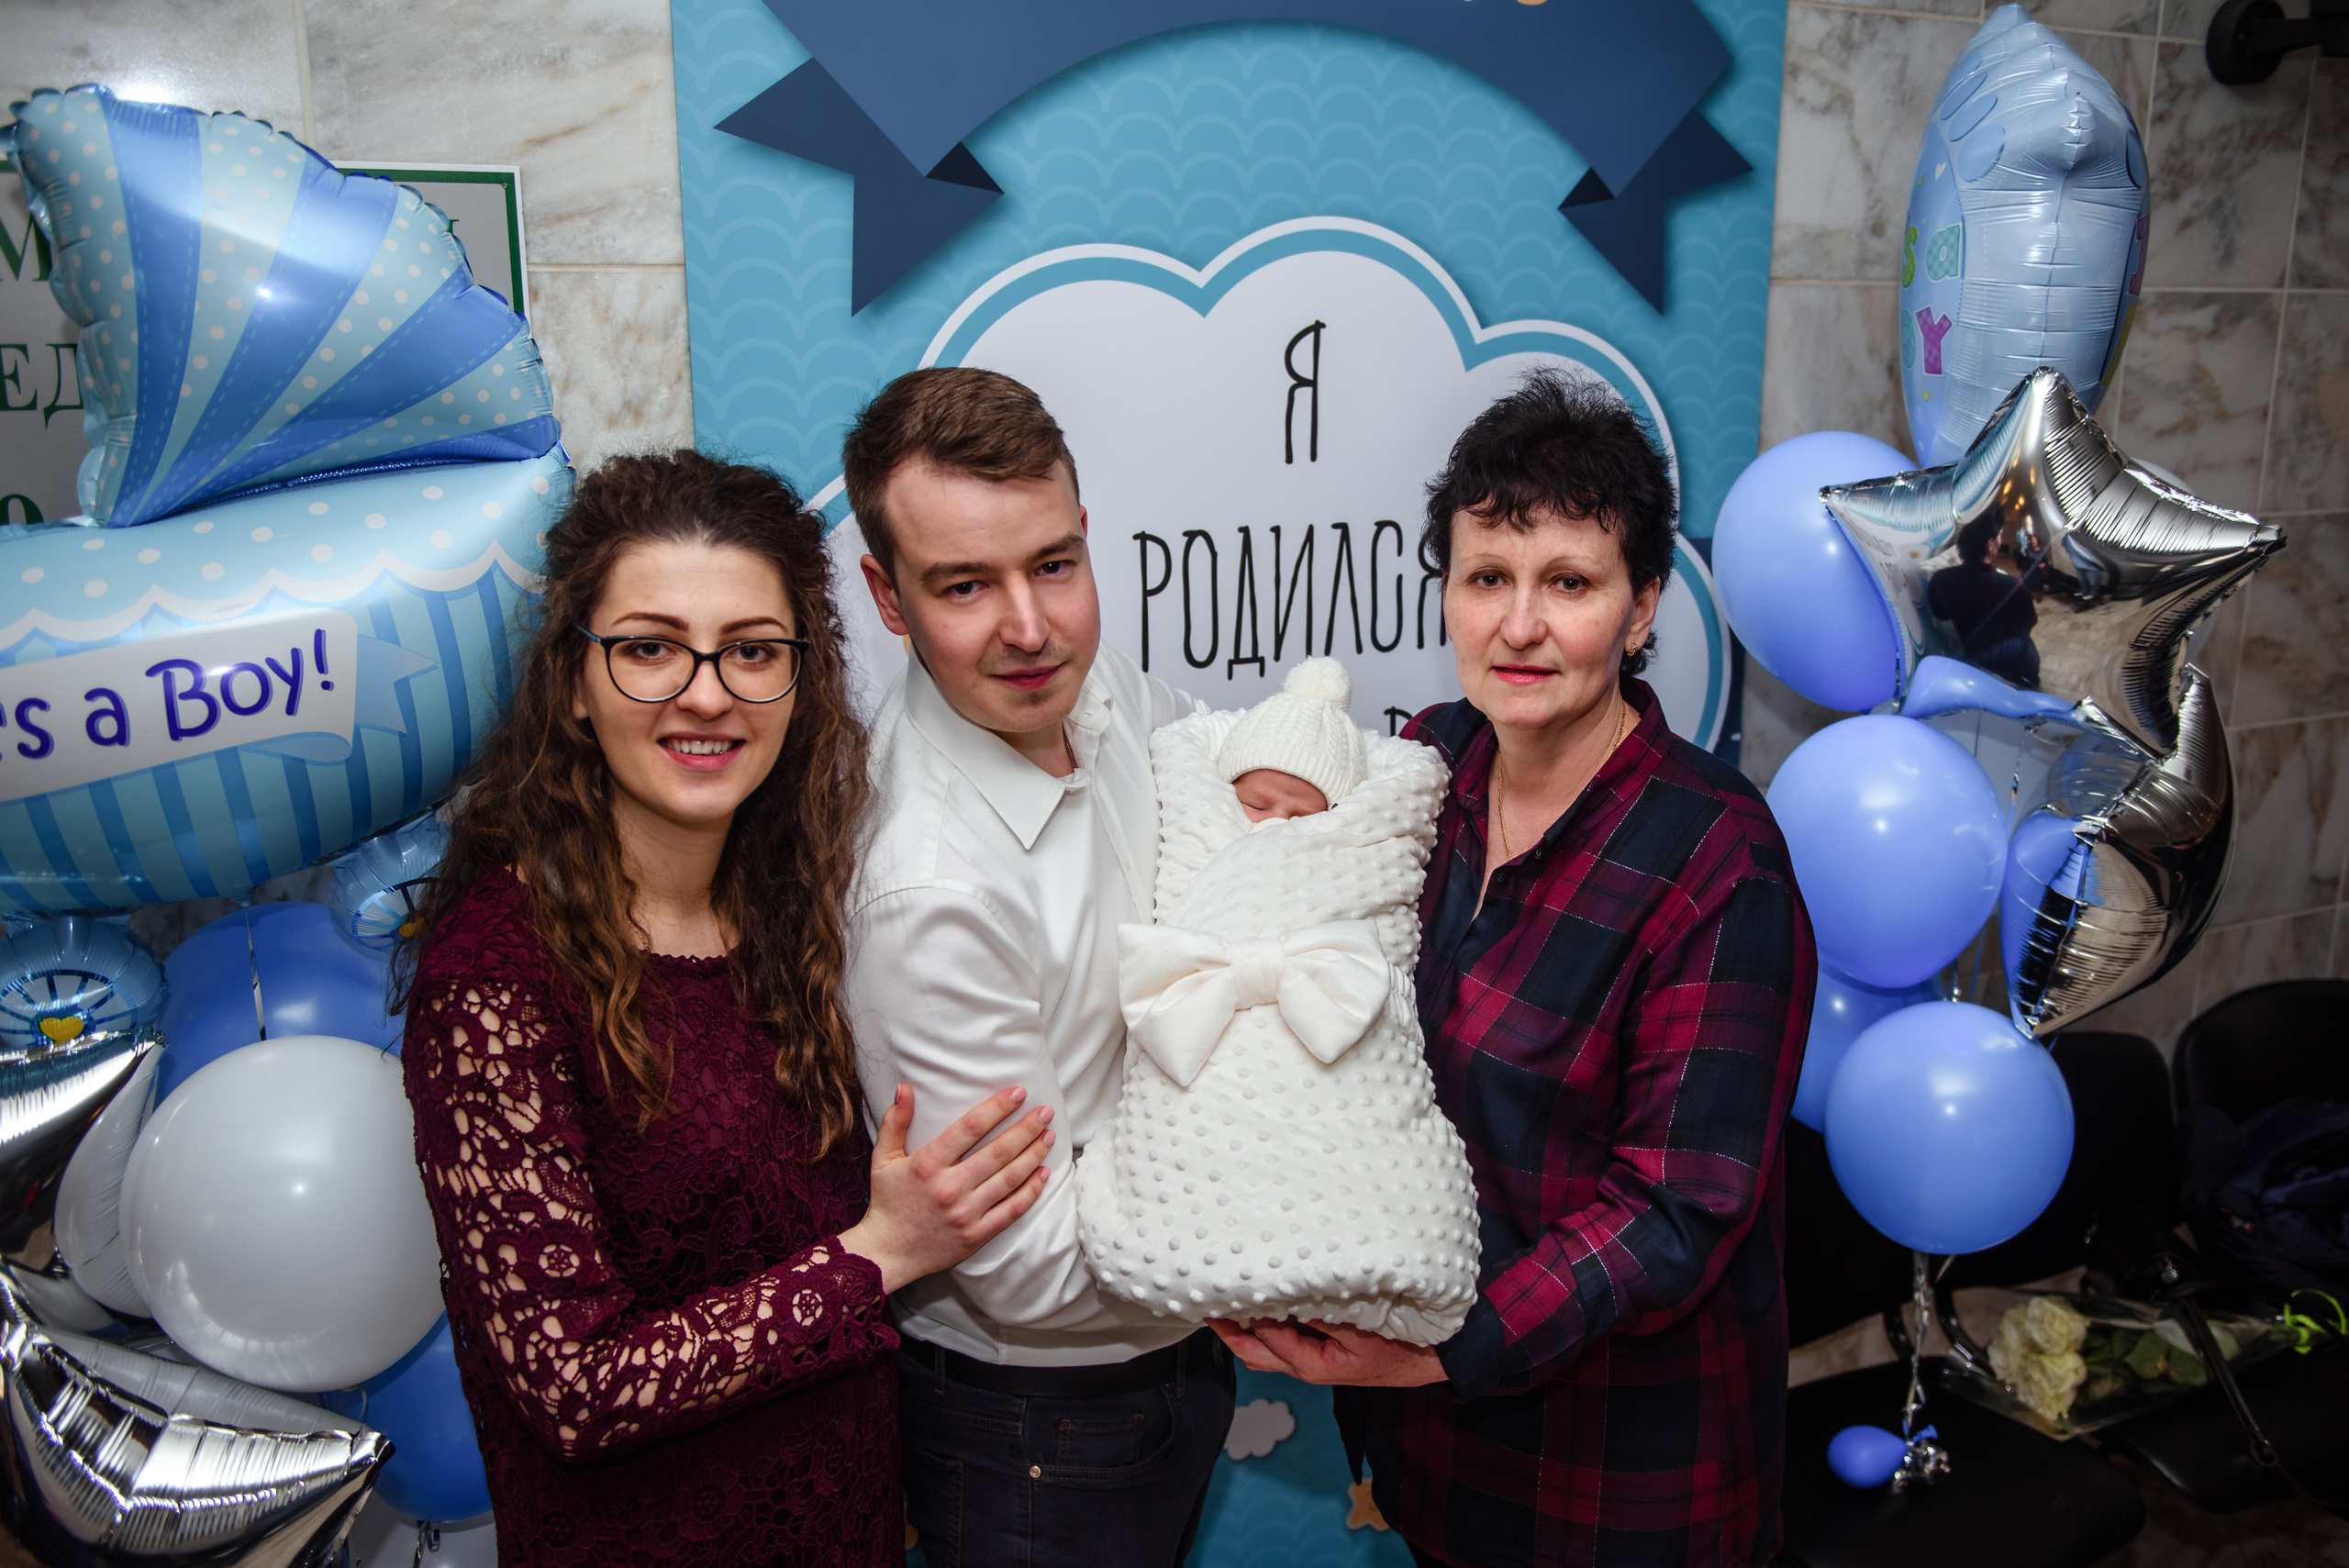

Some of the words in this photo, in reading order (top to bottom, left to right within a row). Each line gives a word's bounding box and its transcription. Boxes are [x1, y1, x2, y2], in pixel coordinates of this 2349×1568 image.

[1284, 319, 1327, 464] Я
[1131, 519, 1447, 681] РОДИЛСЯ
[0, 697, 54, 760] s
[84, 687, 130, 748] a
